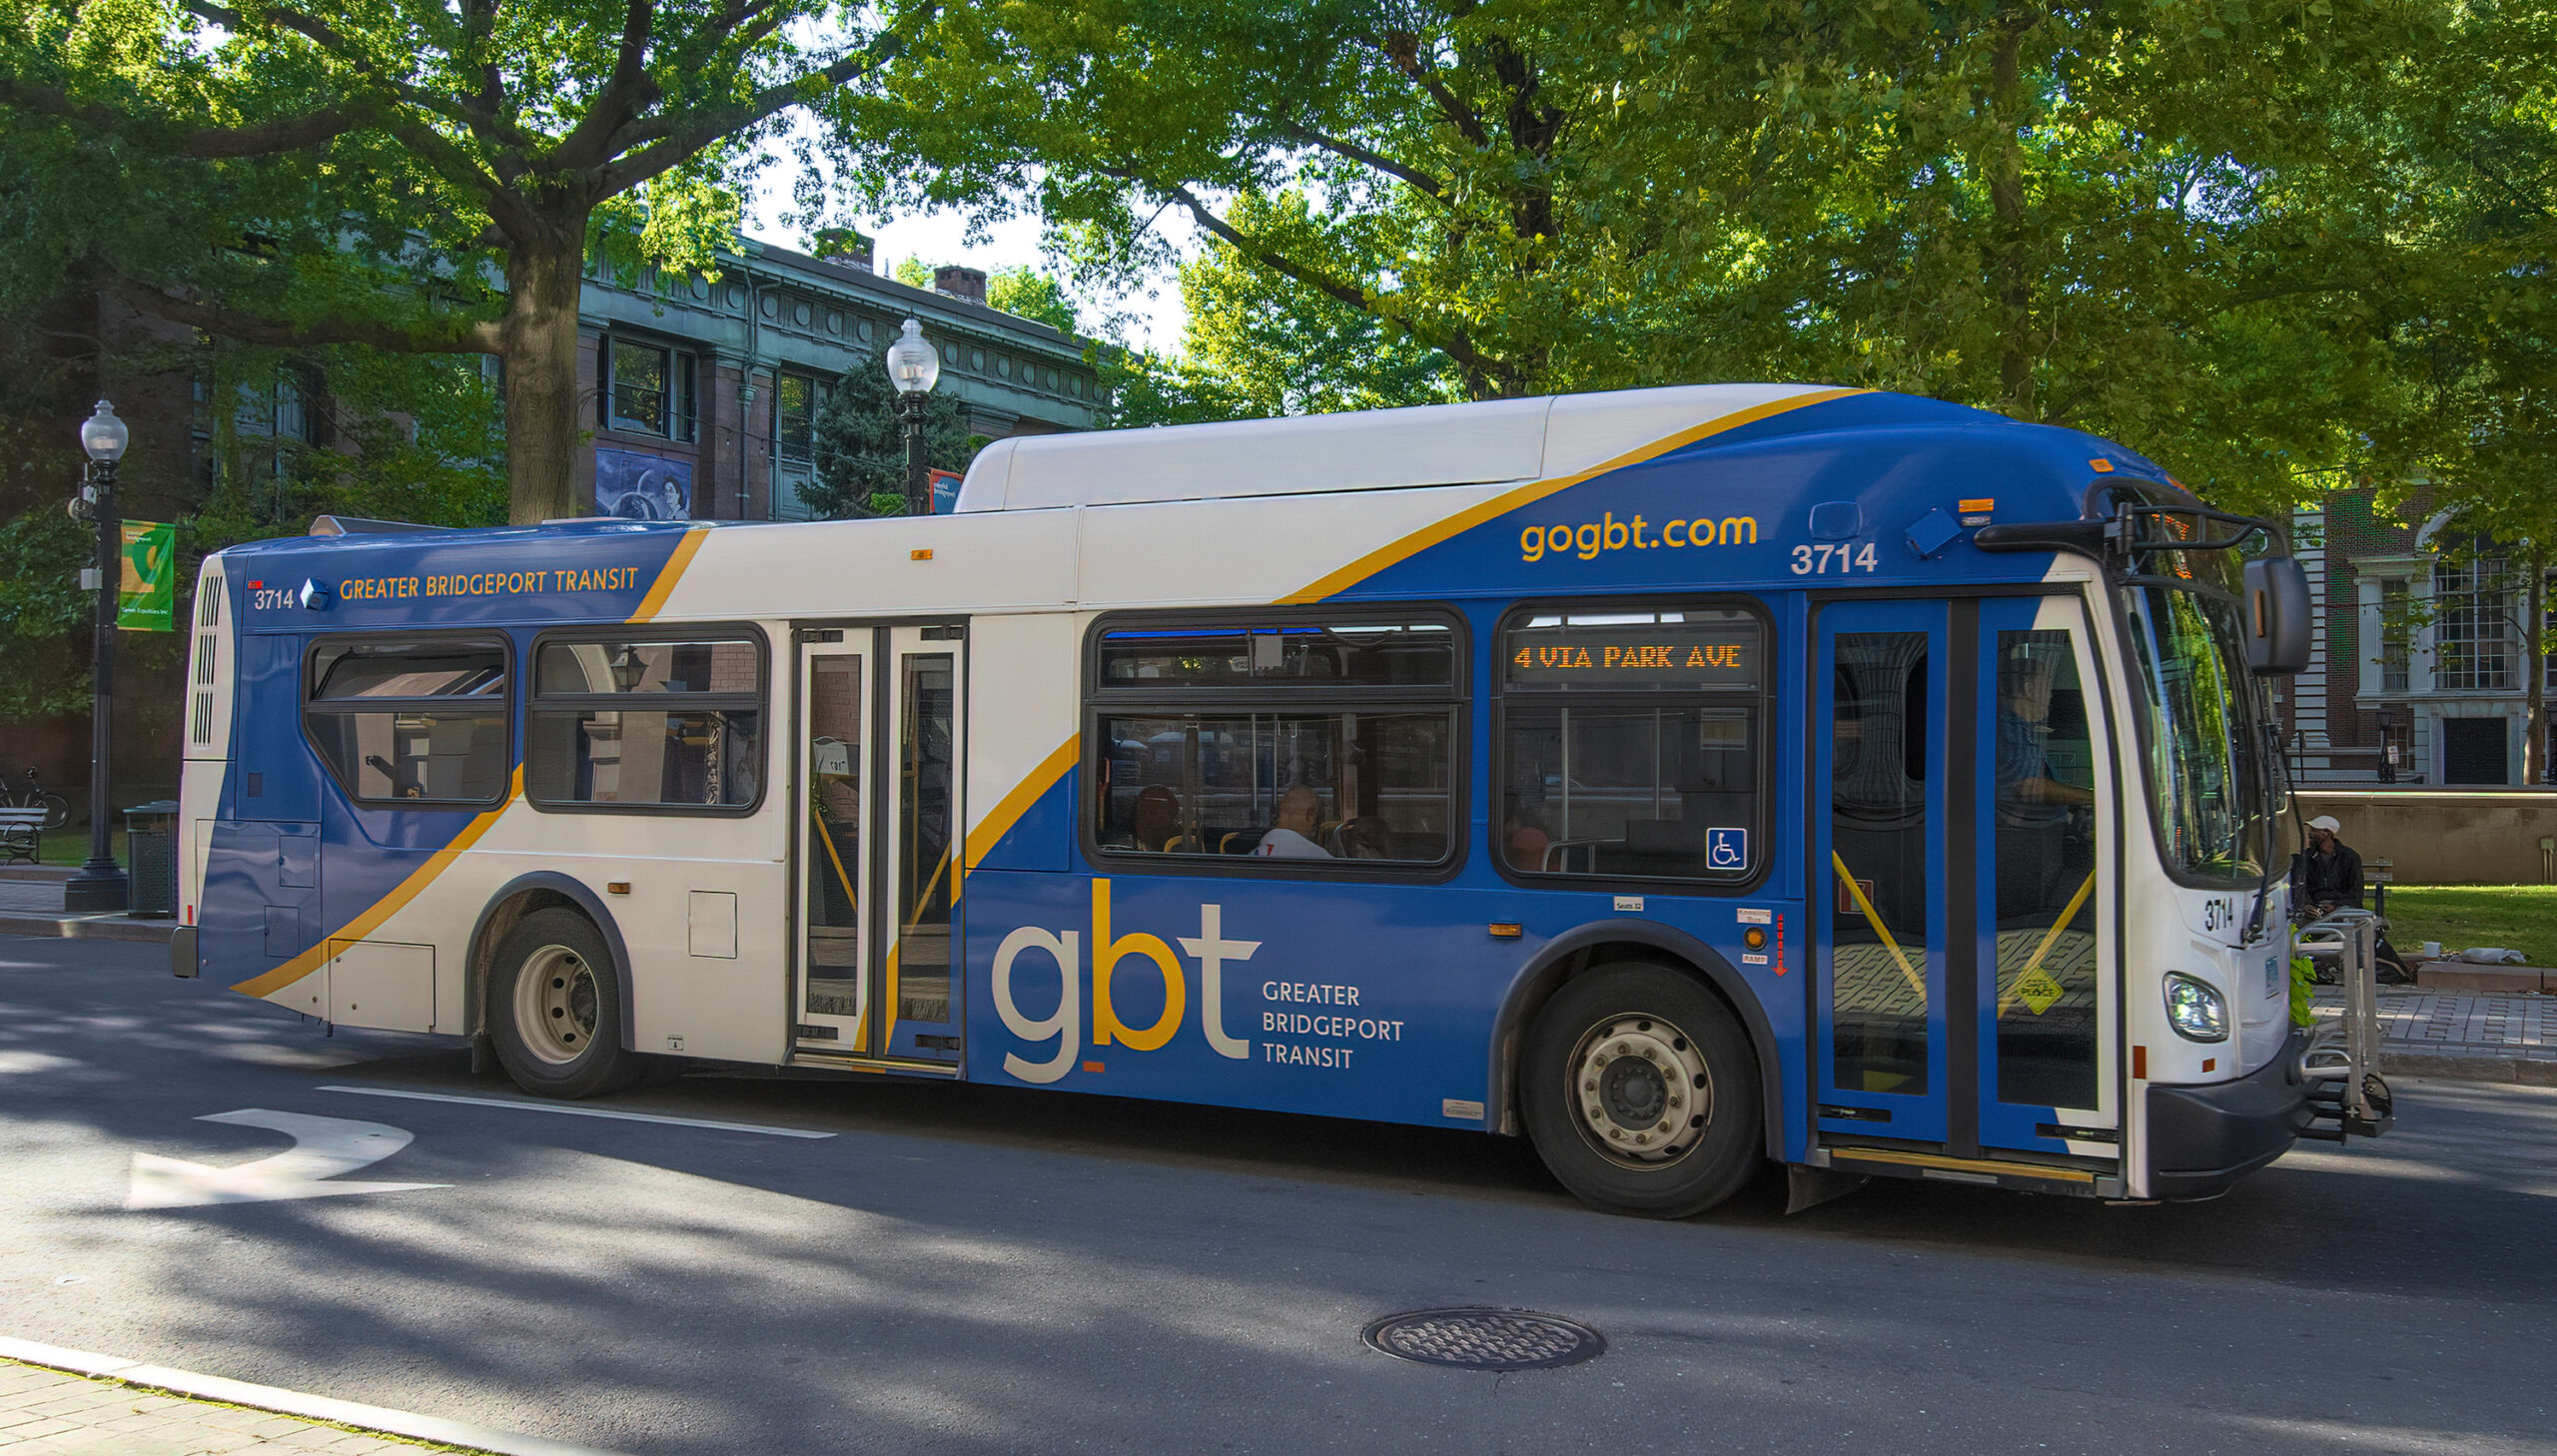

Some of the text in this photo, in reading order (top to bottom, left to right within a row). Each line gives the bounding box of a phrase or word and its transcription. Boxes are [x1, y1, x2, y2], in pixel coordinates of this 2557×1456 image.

[1520, 511, 1758, 561] gogbt.com
[1791, 542, 1878, 575] 3714
[340, 566, 639, 600] GREATER BRIDGEPORT TRANSIT
[254, 589, 294, 610] 3714
[1514, 644, 1742, 668] 4 VIA PARK AVE
[2204, 898, 2233, 932] 3714
[991, 878, 1263, 1084] gbt
[1262, 981, 1360, 1008] GREATER
[1262, 1012, 1404, 1043] BRIDGEPORT
[1262, 1043, 1354, 1070] TRANSIT
